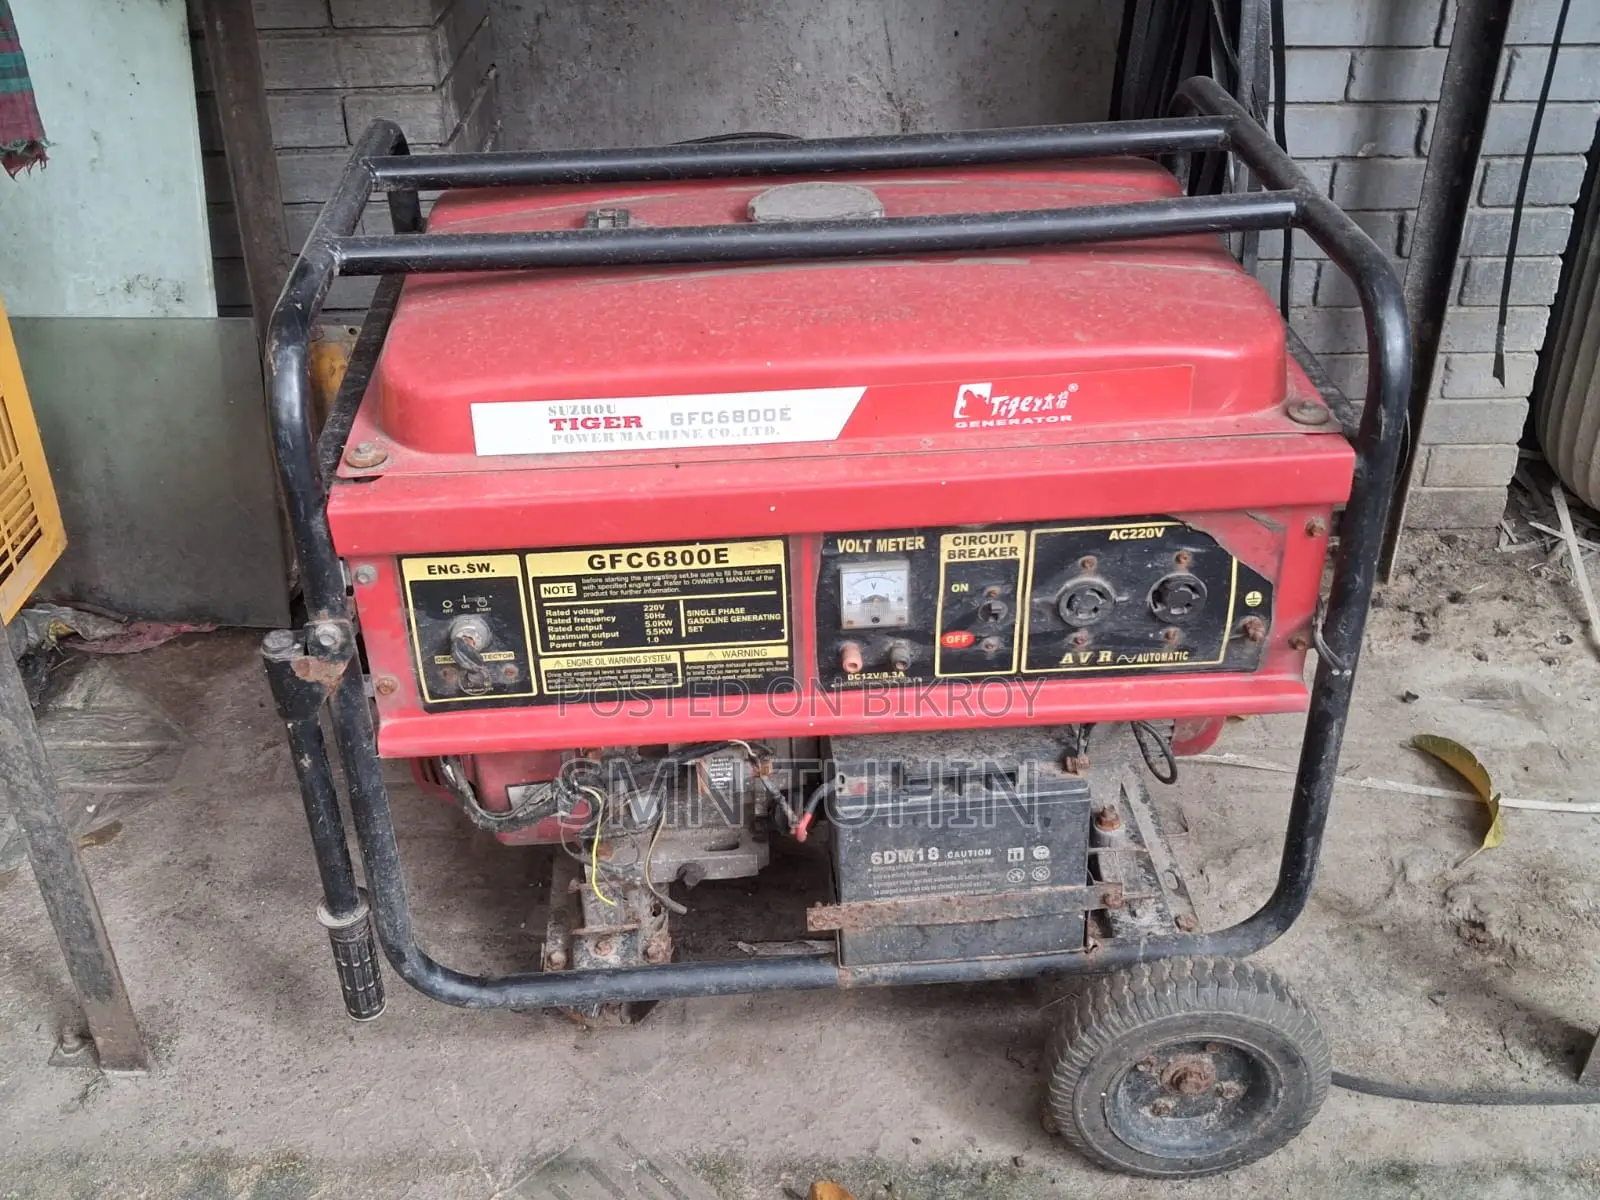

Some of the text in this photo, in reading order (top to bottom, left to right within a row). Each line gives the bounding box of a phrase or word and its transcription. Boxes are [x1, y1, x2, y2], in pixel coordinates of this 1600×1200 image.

[548, 404, 616, 416] SUZHOU
[670, 407, 792, 426] GFC6800E
[955, 415, 1073, 428] GENERATOR
[549, 415, 642, 431] TIGER
[552, 432, 615, 444] POWER
[619, 428, 702, 442] MACHINE
[952, 533, 1014, 546] CIRCUIT
[1109, 527, 1165, 540] AC220V
[837, 536, 925, 553] VOLT METER
[587, 548, 729, 570] GFC6800E
[947, 546, 1018, 560] BREAKER
[427, 562, 495, 575] ENG.SW.
[543, 586, 574, 595] NOTE
[951, 584, 969, 592] ON
[572, 608, 604, 616] voltage
[574, 615, 616, 624] frequency
[687, 614, 781, 624] GASOLINE GENERATING
[574, 624, 603, 632] output
[646, 628, 674, 636] 5.5KW
[548, 632, 619, 640] Maximum output
[946, 634, 969, 644] OFF
[722, 648, 768, 658] WARNING
[1137, 651, 1189, 663] AUTOMATIC
[566, 654, 672, 666] ENGINE OIL WARNING SYSTEM
[871, 846, 992, 865] 6DM18 CAUTION
